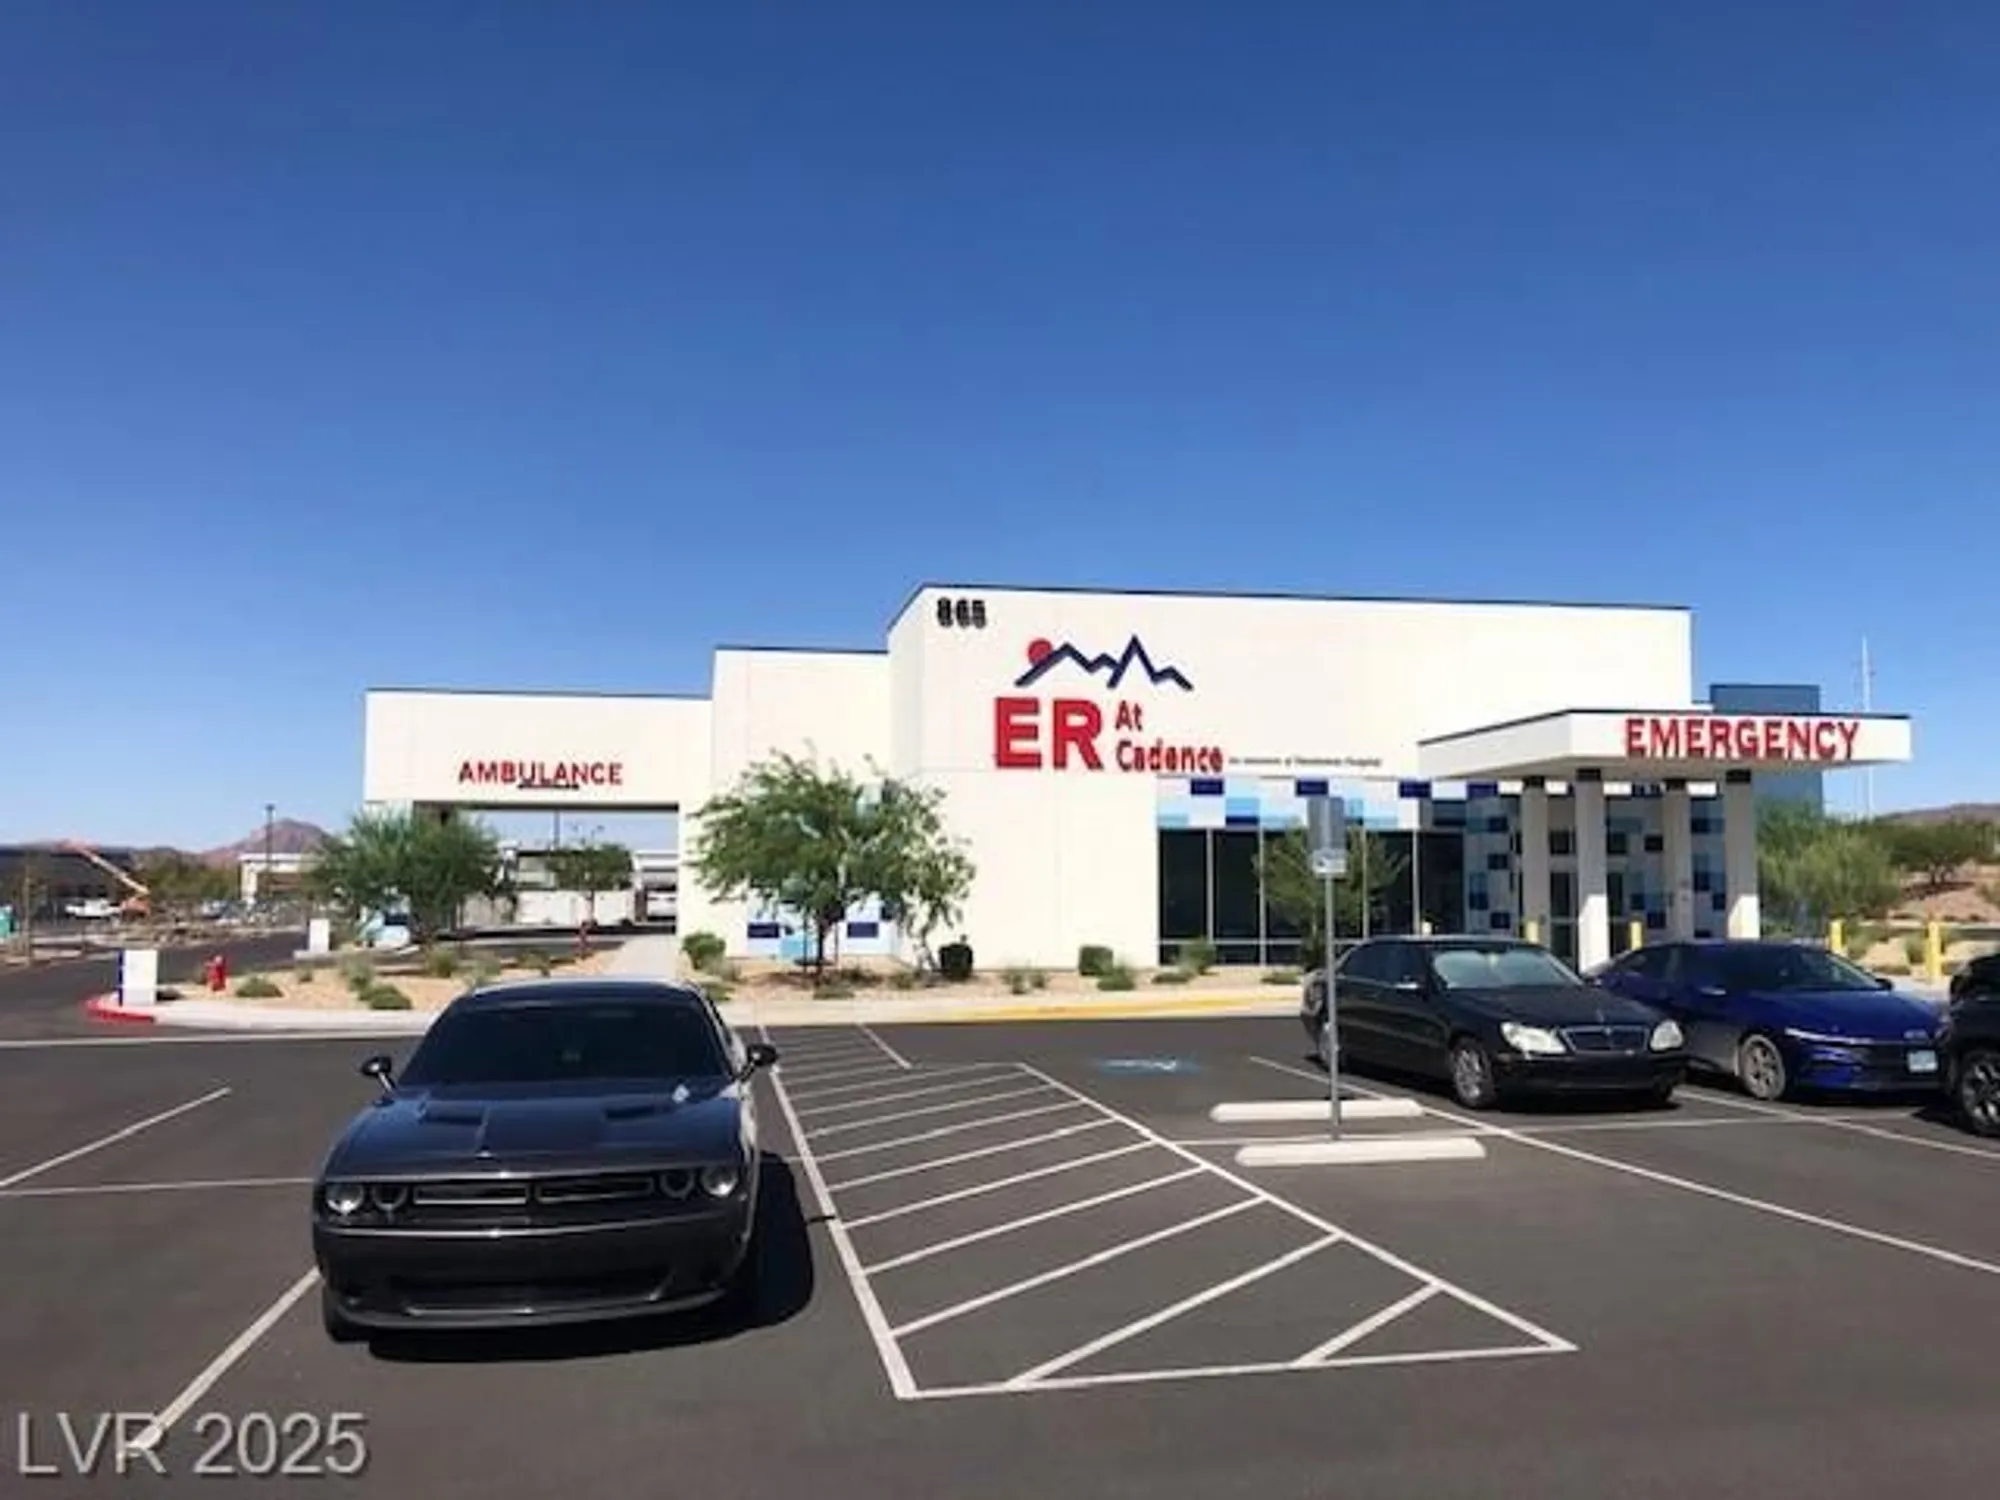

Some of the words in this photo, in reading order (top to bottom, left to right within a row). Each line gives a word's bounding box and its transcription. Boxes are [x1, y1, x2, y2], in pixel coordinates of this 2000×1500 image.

[1115, 700, 1143, 731] At
[995, 697, 1104, 770] ER
[1625, 717, 1859, 760] EMERGENCY
[1116, 738, 1223, 772] Cadence
[458, 760, 623, 786] AMBULANCE
